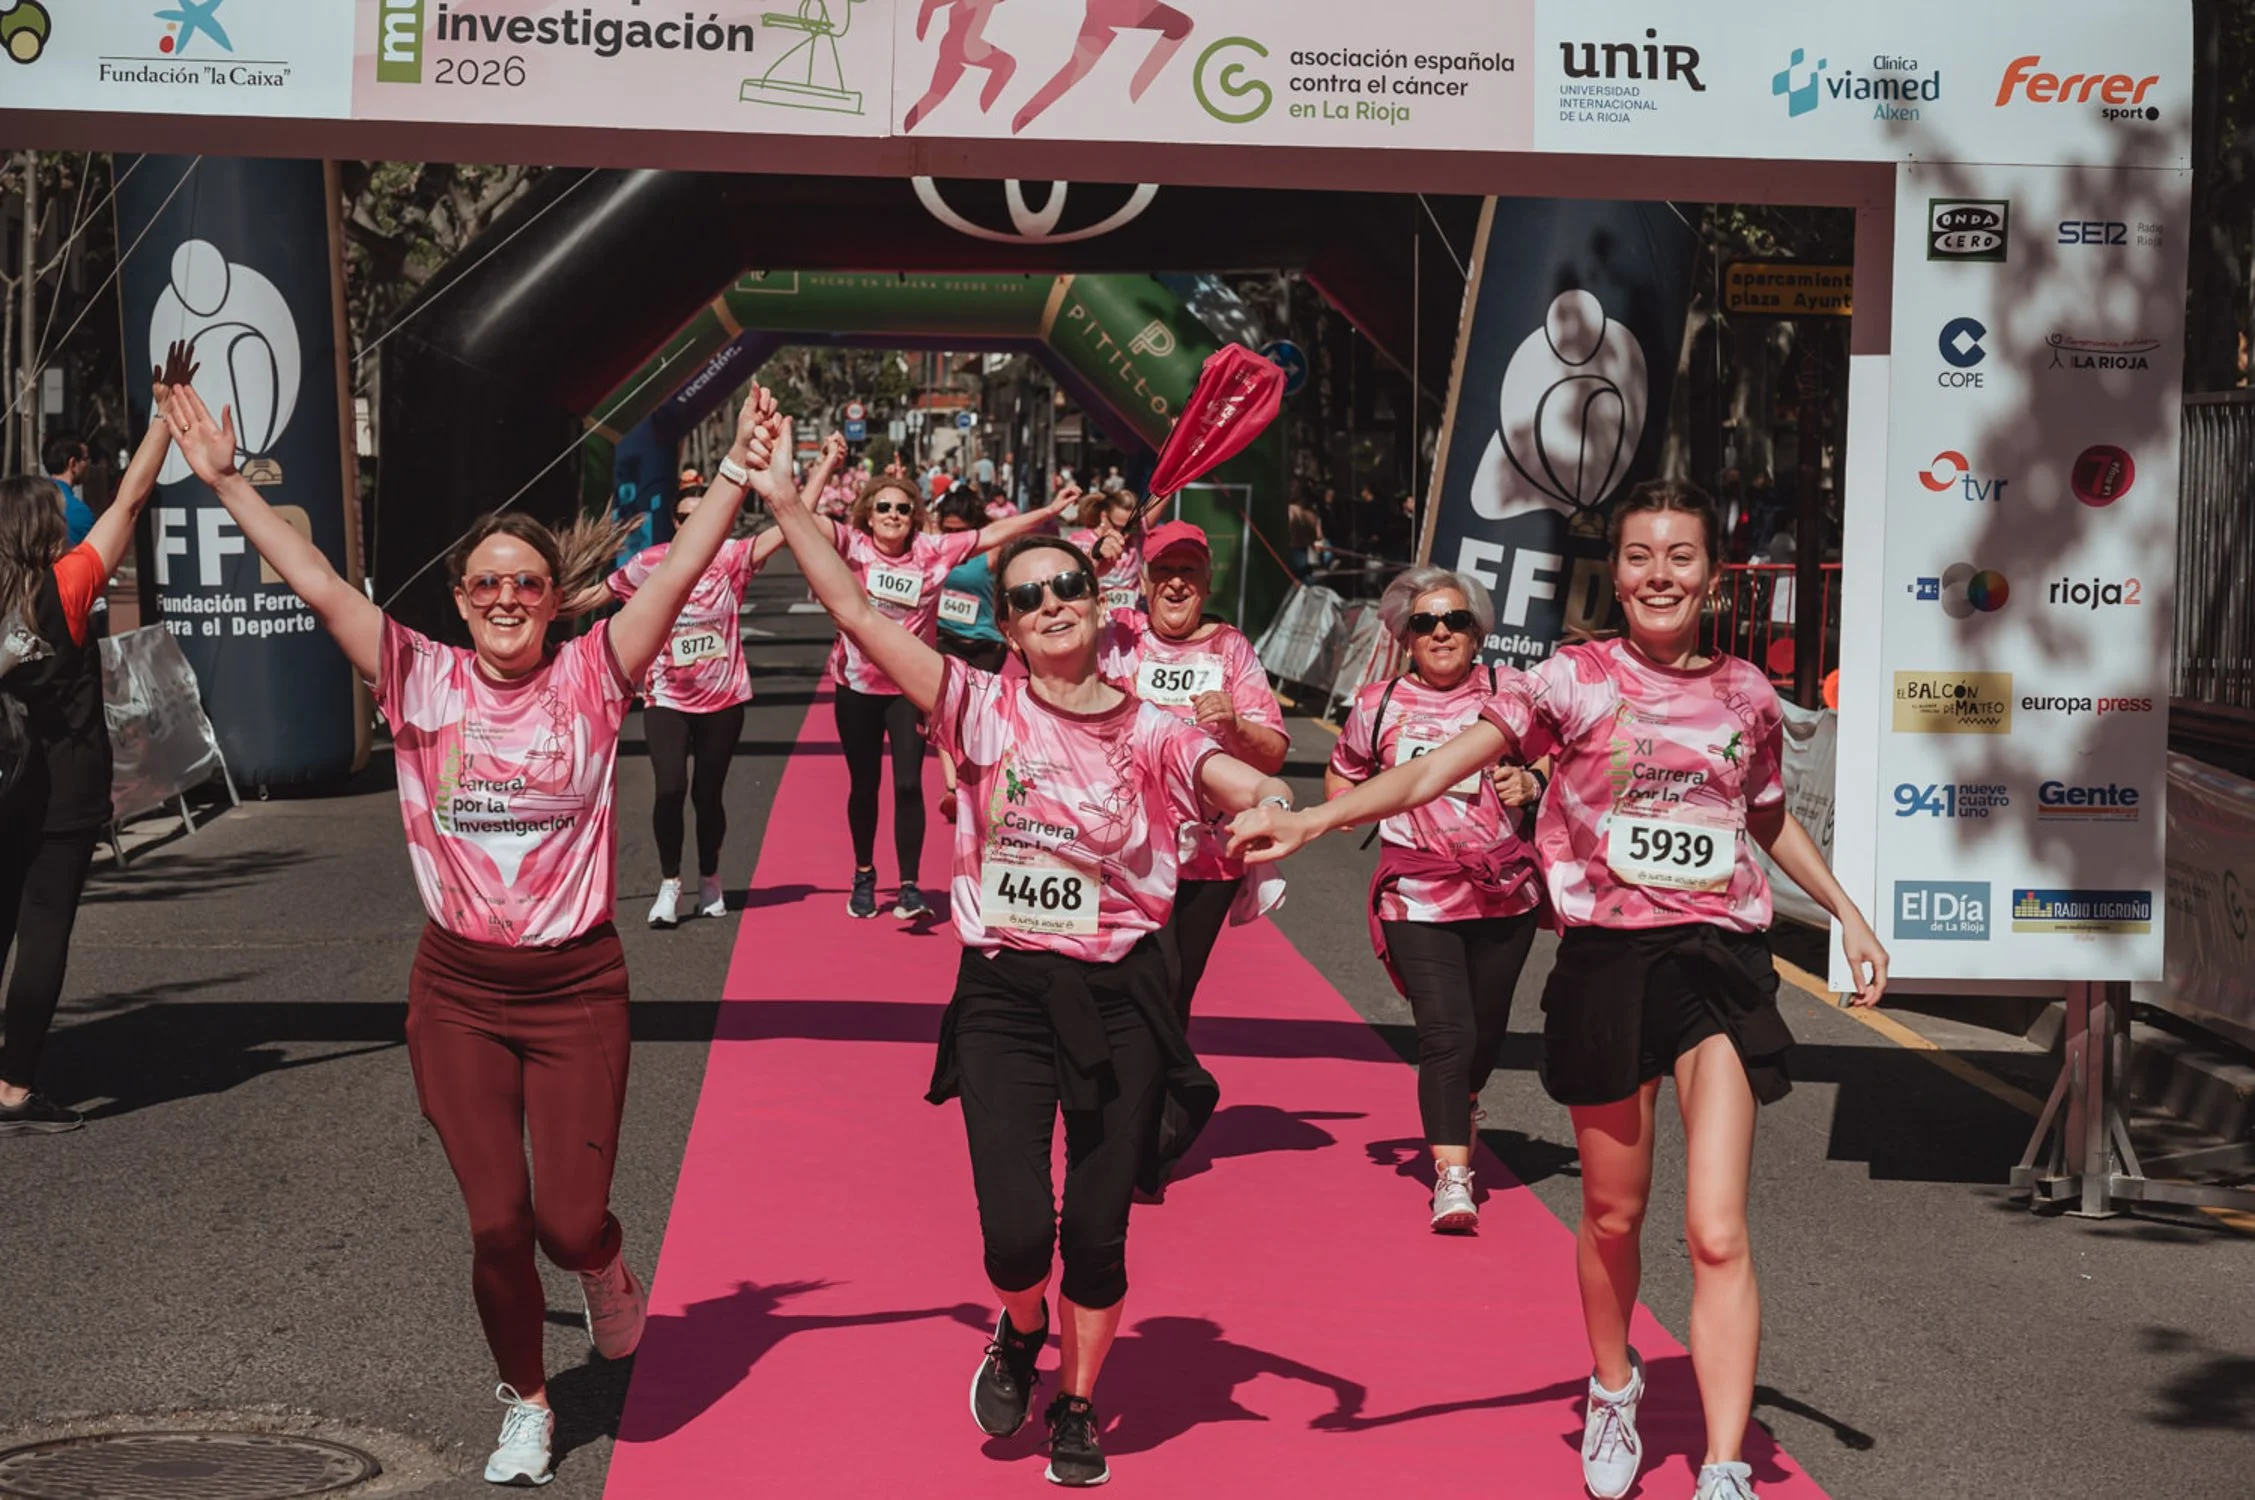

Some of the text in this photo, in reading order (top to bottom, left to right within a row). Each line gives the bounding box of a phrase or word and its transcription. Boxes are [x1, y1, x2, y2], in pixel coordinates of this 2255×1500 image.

[436, 4, 755, 57] investigación
[1290, 48, 1515, 74] asociación española
[99, 63, 199, 84] Fundación
[435, 56, 526, 87] 2026
[1289, 74, 1468, 96] contra el cáncer
[1560, 85, 1640, 97] UNIVERSIDAD
[1826, 71, 1940, 101] viamed
[1289, 101, 1410, 126] en La Rioja
[1560, 98, 1658, 111] INTERNACIONAL
[2102, 107, 2144, 121] sport
[1560, 111, 1631, 123] DE LA RIOJA
[1941, 213, 1994, 226] ONDA
[1944, 235, 1993, 248] CERO
[2099, 356, 2149, 370] RIOJA
[1938, 373, 1983, 387] COPE
[1962, 474, 2008, 501] tvr
[878, 574, 913, 594] 1067
[2050, 578, 2141, 610] rioja2
[944, 599, 972, 614] 6401
[161, 613, 316, 638] ara el Deporte
[681, 635, 716, 655] 8772
[1908, 679, 1979, 699] BALCÓN
[1955, 700, 2005, 716] MATEO
[2022, 695, 2153, 715] europa press
[1634, 738, 1652, 757] XI
[458, 773, 524, 793] Carrera
[1632, 762, 1705, 785] Carrera
[1959, 784, 2007, 795] nueve
[2038, 781, 2140, 806] Gente
[453, 797, 506, 815] por la
[1894, 783, 1956, 818] 941
[1959, 796, 2010, 807] cuatro
[1959, 807, 1989, 818] uno
[1004, 811, 1075, 841] Carrera
[1629, 826, 1714, 868] 5939
[998, 871, 1082, 911] 4468
[1902, 890, 1984, 922] El Día
[2054, 899, 2150, 919] RADIO LOGROÑO
[1930, 922, 1985, 934] de La Rioja
